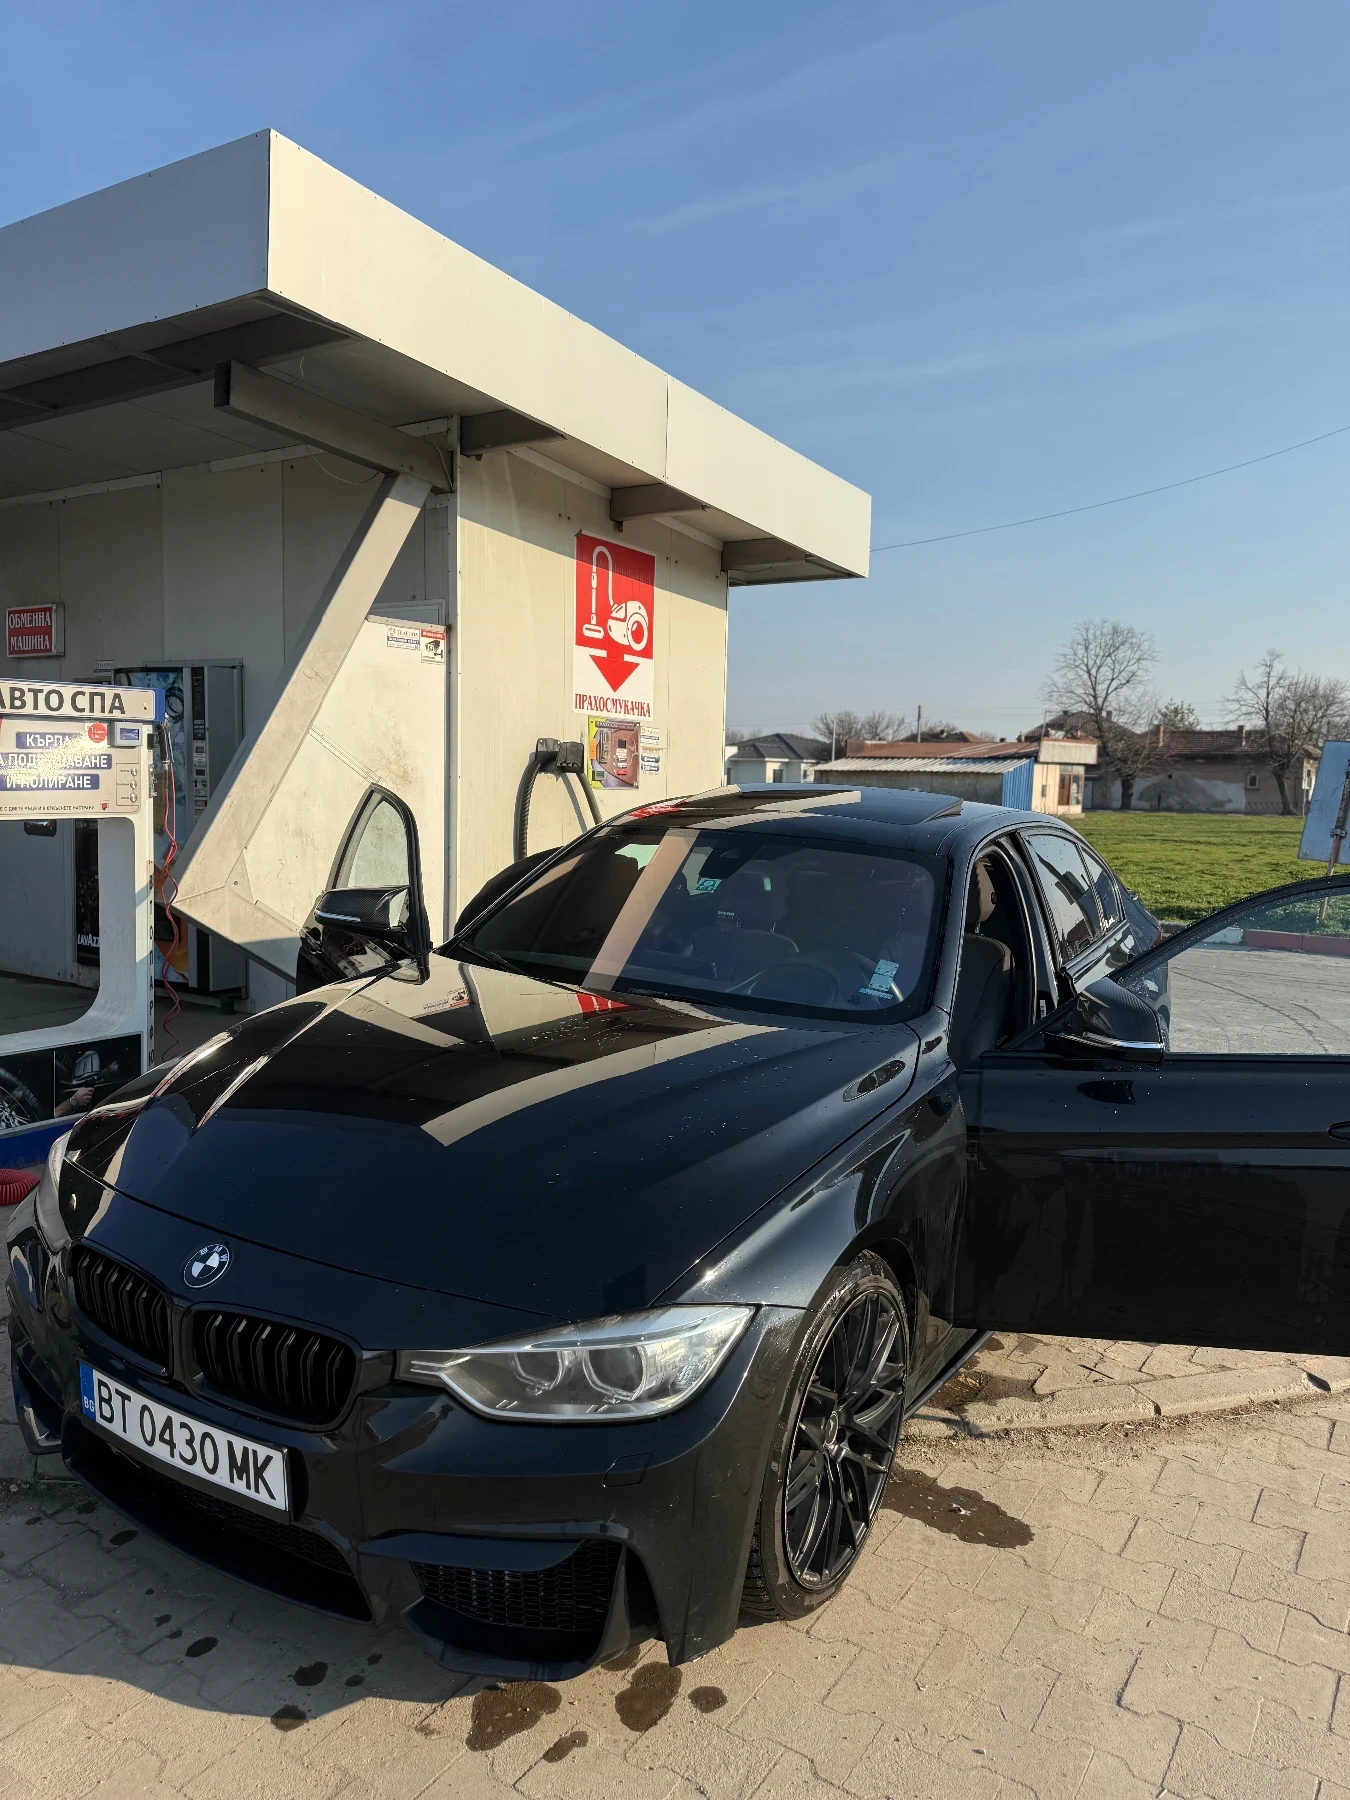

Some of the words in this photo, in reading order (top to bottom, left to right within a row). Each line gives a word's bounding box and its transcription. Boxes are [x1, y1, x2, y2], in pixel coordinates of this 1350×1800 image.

[9, 611, 51, 629] ОБМЕННА
[10, 635, 50, 651] МАШИНА
[70, 690, 126, 715] СПА
[574, 692, 651, 717] ПРАХОСМУКАЧКА
[77, 933, 101, 948] LAVAZZ
[200, 1245, 228, 1262] BMW
[83, 1395, 95, 1413] BG
[97, 1378, 132, 1434] BT
[139, 1404, 219, 1475] 0430
[226, 1439, 276, 1500] MK
